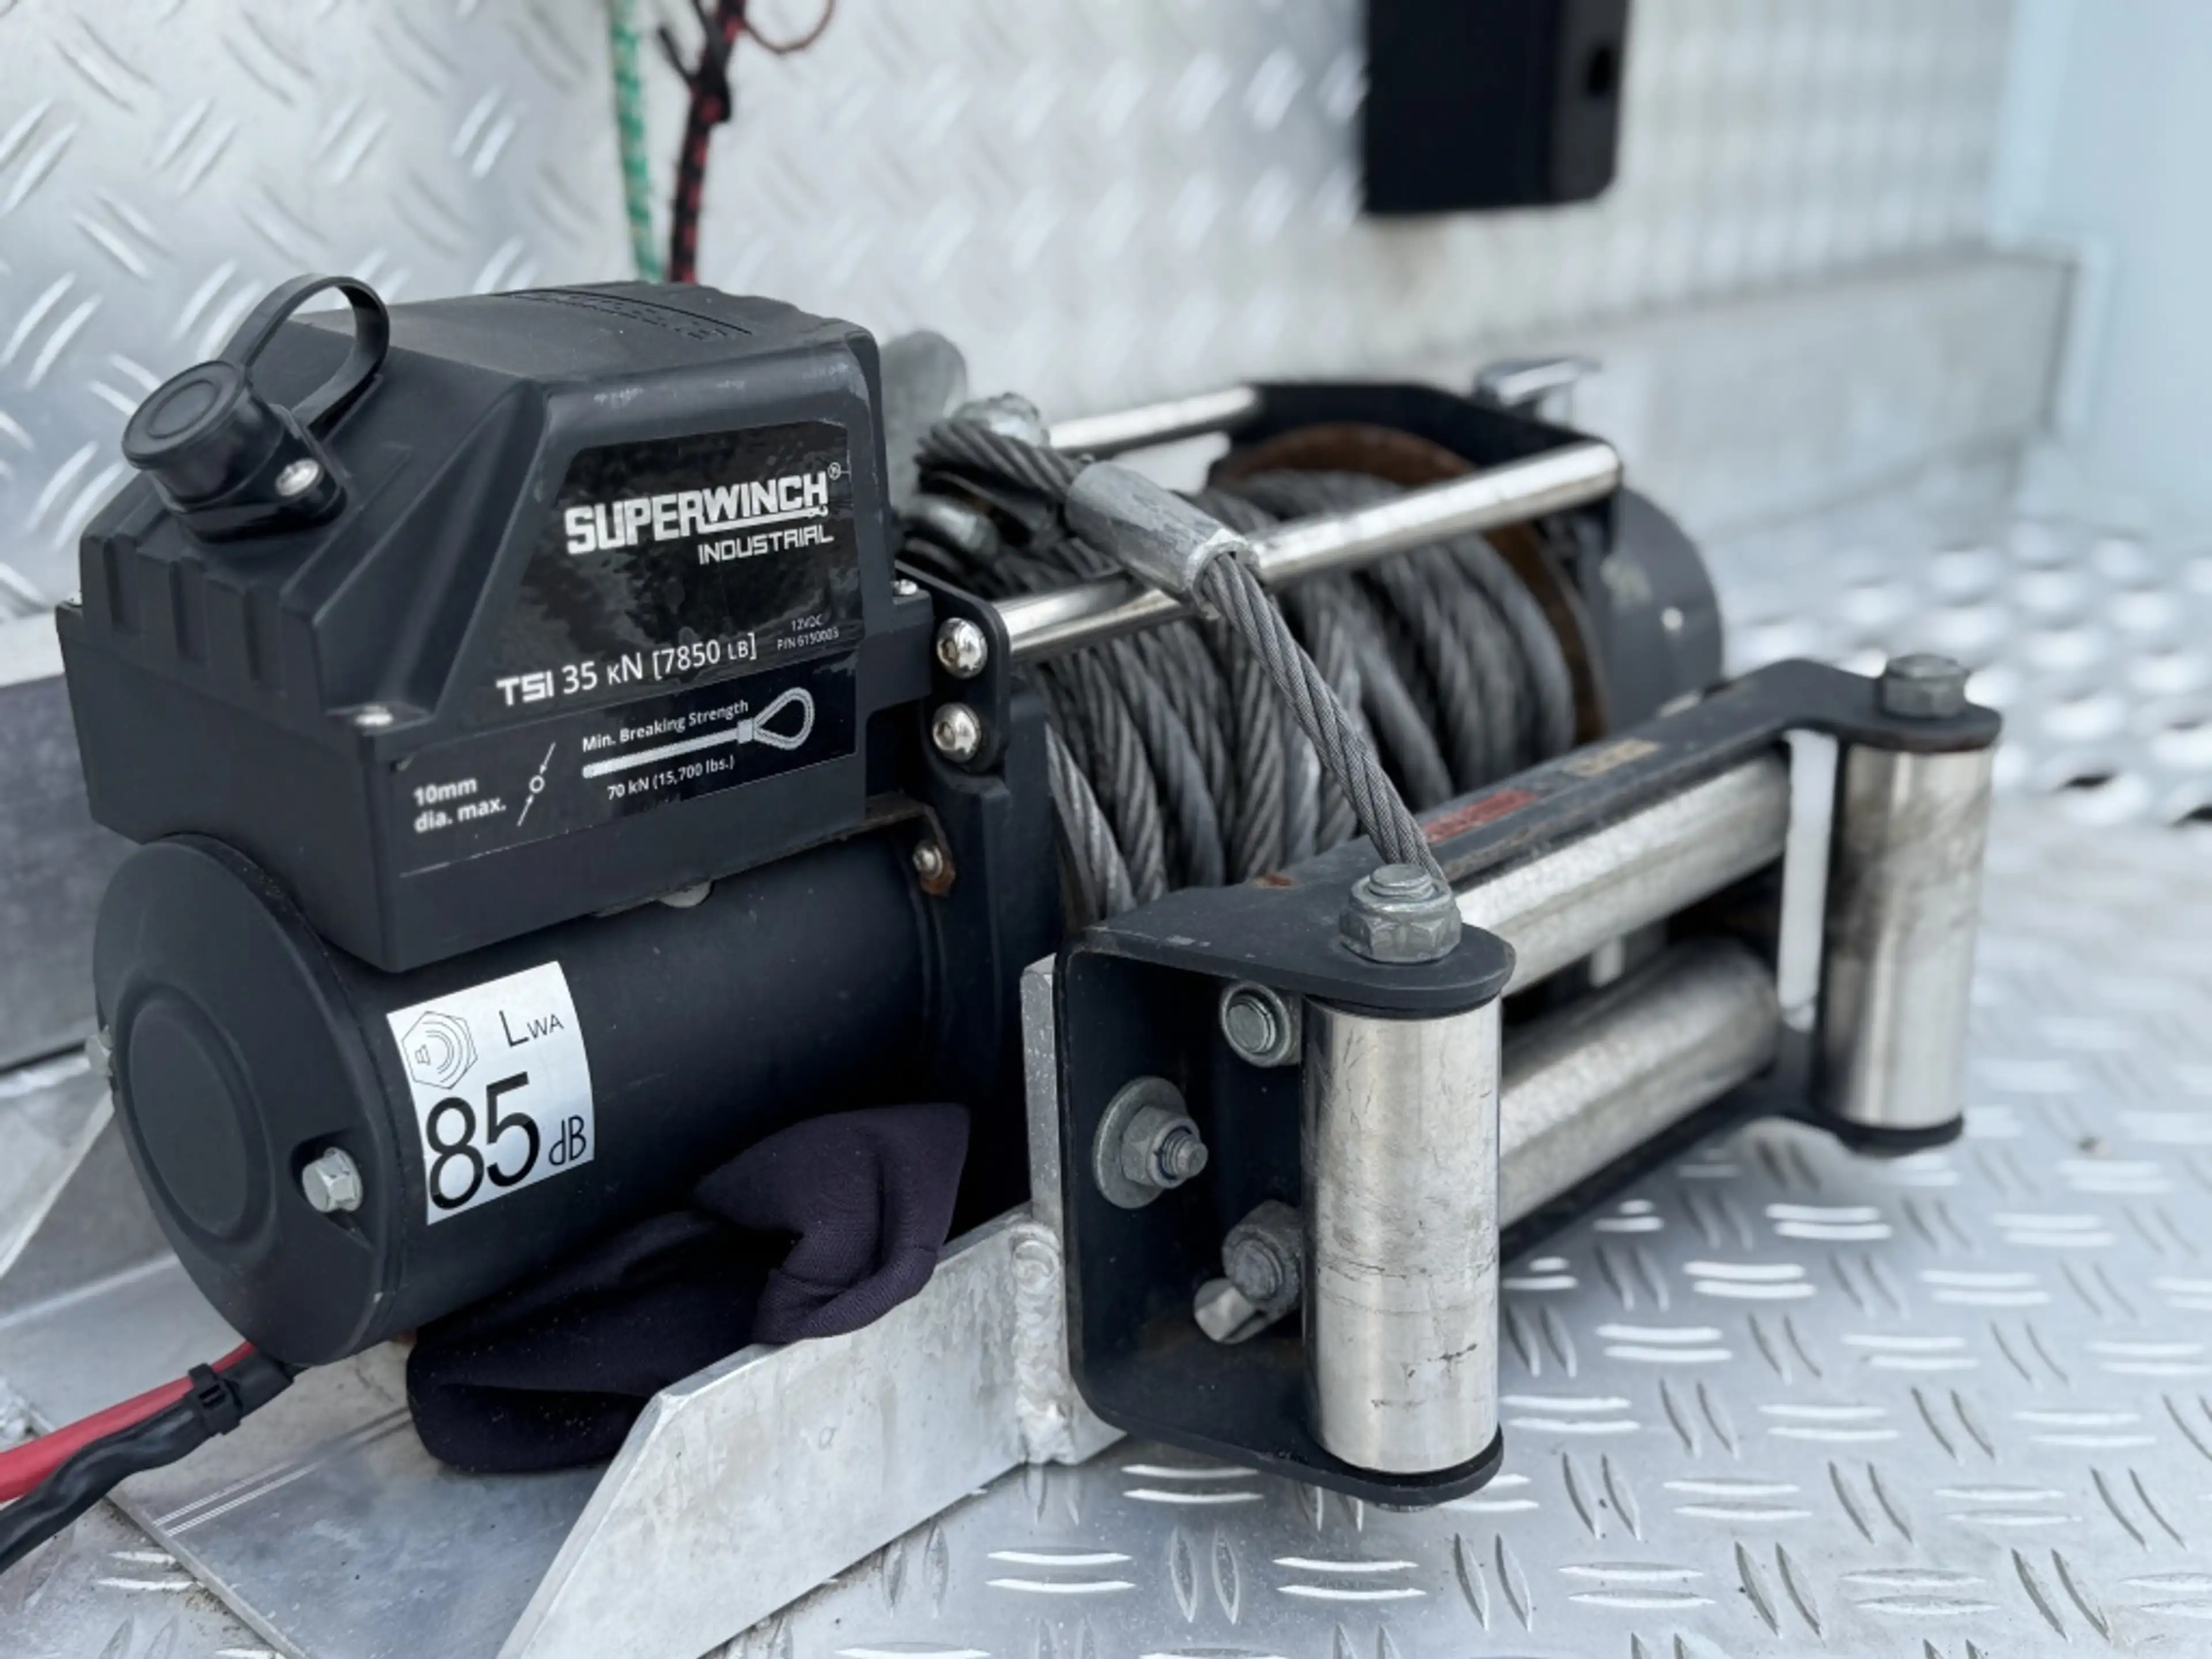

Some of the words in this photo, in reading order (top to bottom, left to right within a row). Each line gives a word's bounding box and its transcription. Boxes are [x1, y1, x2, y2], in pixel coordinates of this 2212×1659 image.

[698, 524, 835, 565] INDUSTRIAL
[495, 669, 555, 706] TSI
[561, 660, 598, 695] 35
[652, 639, 721, 681] [7850
[582, 732, 616, 752] Min.
[619, 717, 685, 744] Breaking
[689, 699, 749, 725] Strength
[413, 778, 478, 807] 10mm
[607, 784, 625, 800] 70
[628, 775, 649, 794] kN
[652, 762, 703, 790] (15,700
[706, 753, 736, 775] lbs.)
[414, 809, 454, 834] dia.
[457, 797, 507, 822] max.
[425, 1071, 541, 1210] 85
[548, 1115, 587, 1166] dB
